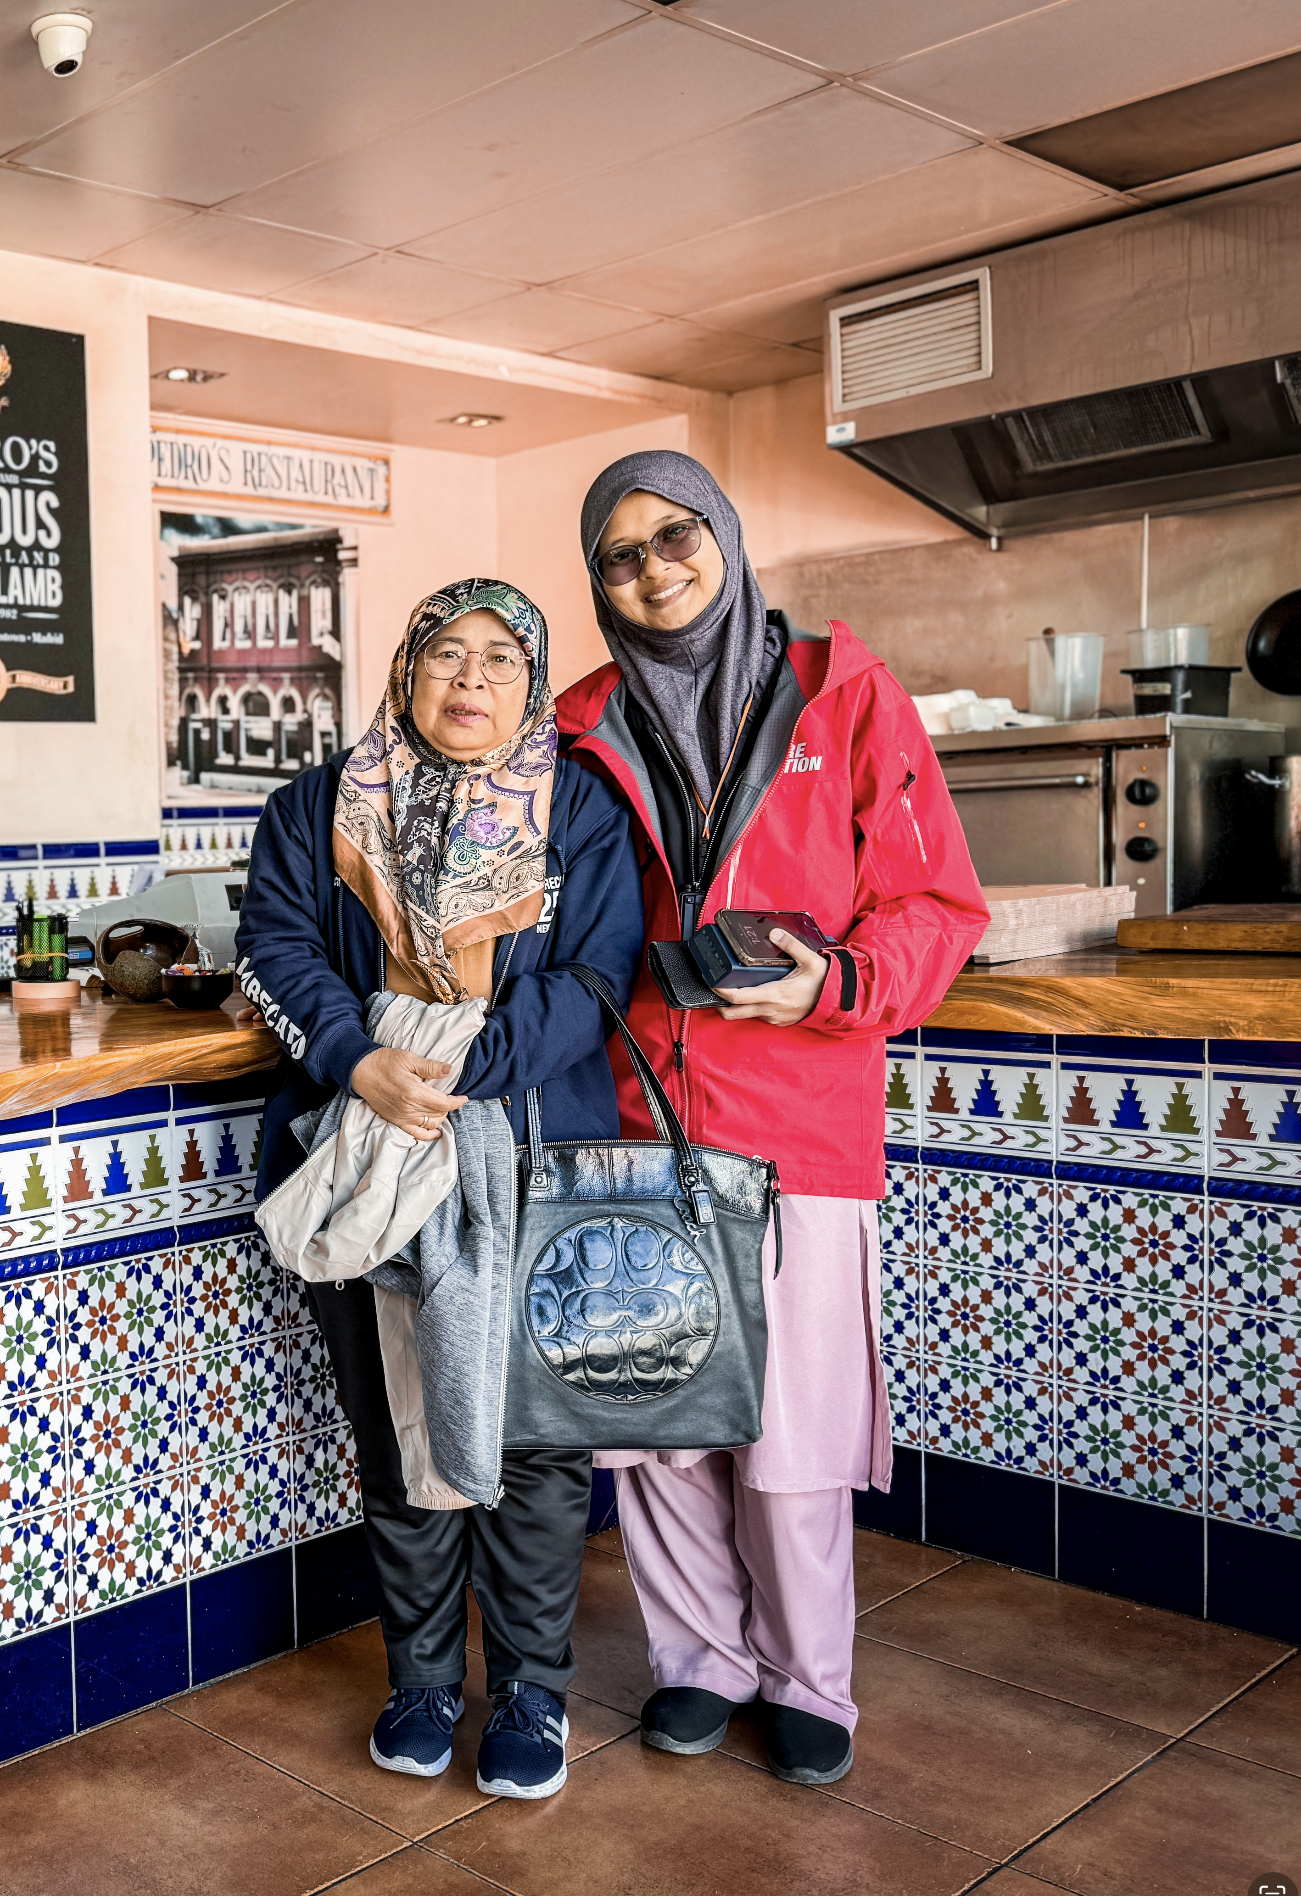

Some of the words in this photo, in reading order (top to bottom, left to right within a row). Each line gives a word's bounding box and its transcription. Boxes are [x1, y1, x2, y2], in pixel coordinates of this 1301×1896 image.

[242, 449, 378, 501] RESTAURANT
[32, 632, 64, 645] Madrid
[15, 673, 64, 690] ANNIVERSARY
